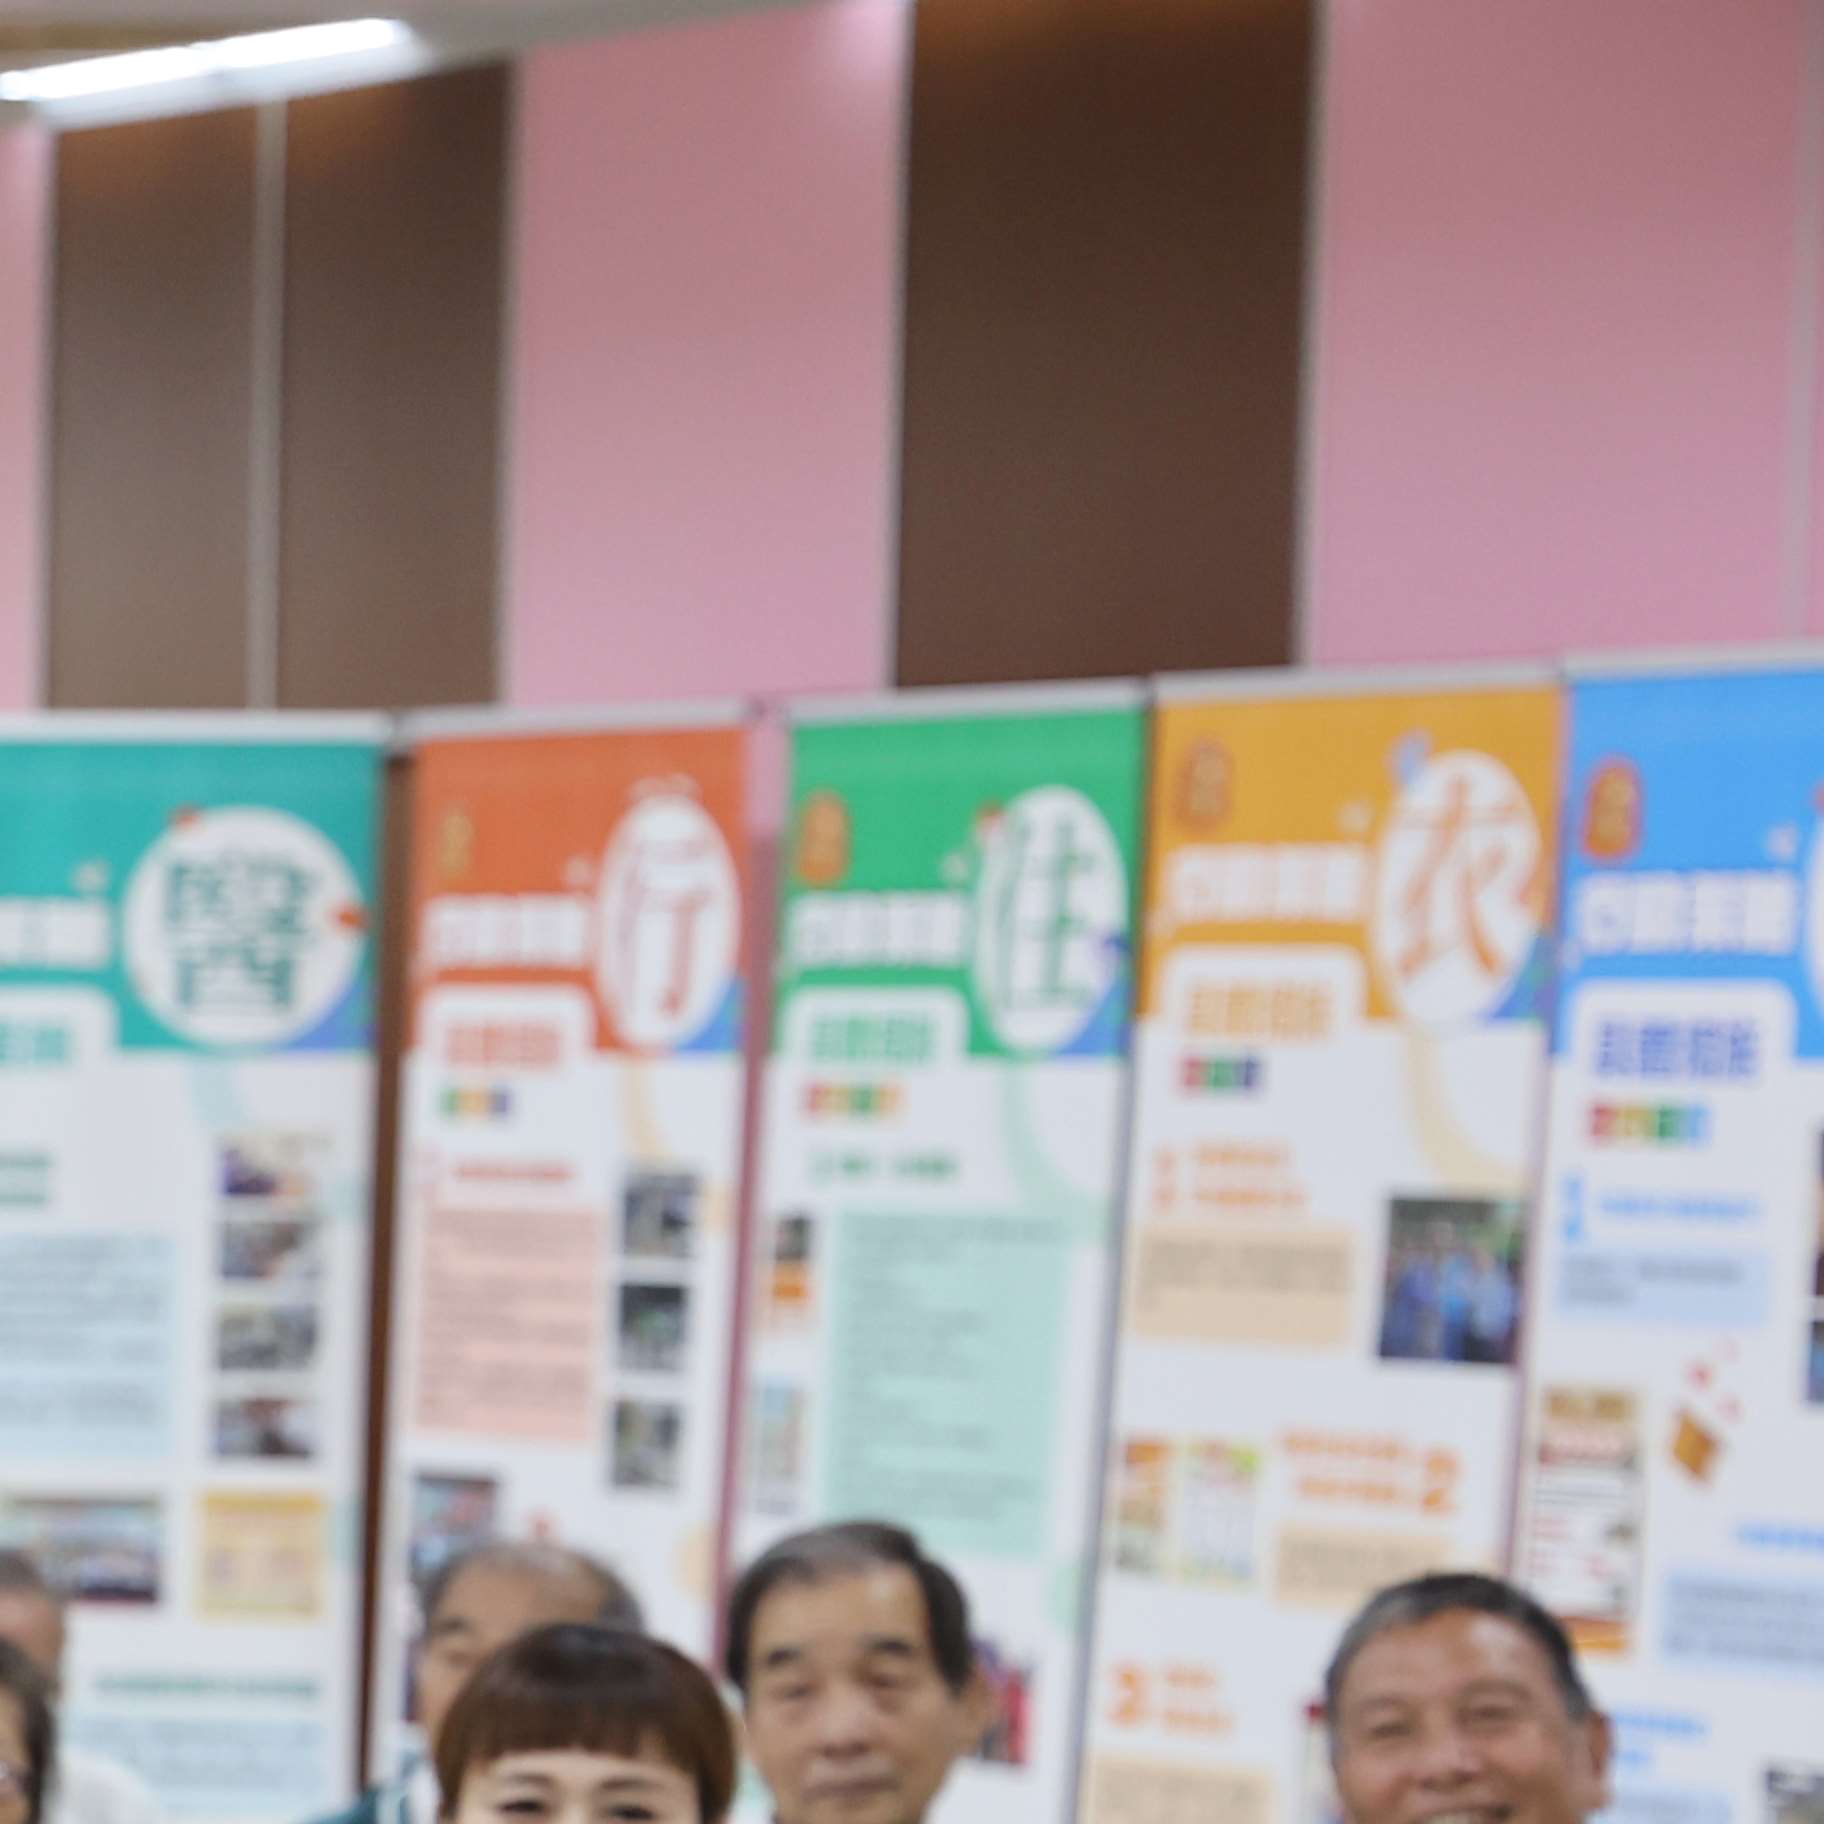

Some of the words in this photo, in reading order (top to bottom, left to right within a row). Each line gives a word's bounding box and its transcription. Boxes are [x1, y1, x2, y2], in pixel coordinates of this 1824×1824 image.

[158, 861, 315, 1013] 醫
[615, 809, 711, 1020] 行
[1390, 766, 1527, 992] 衣
